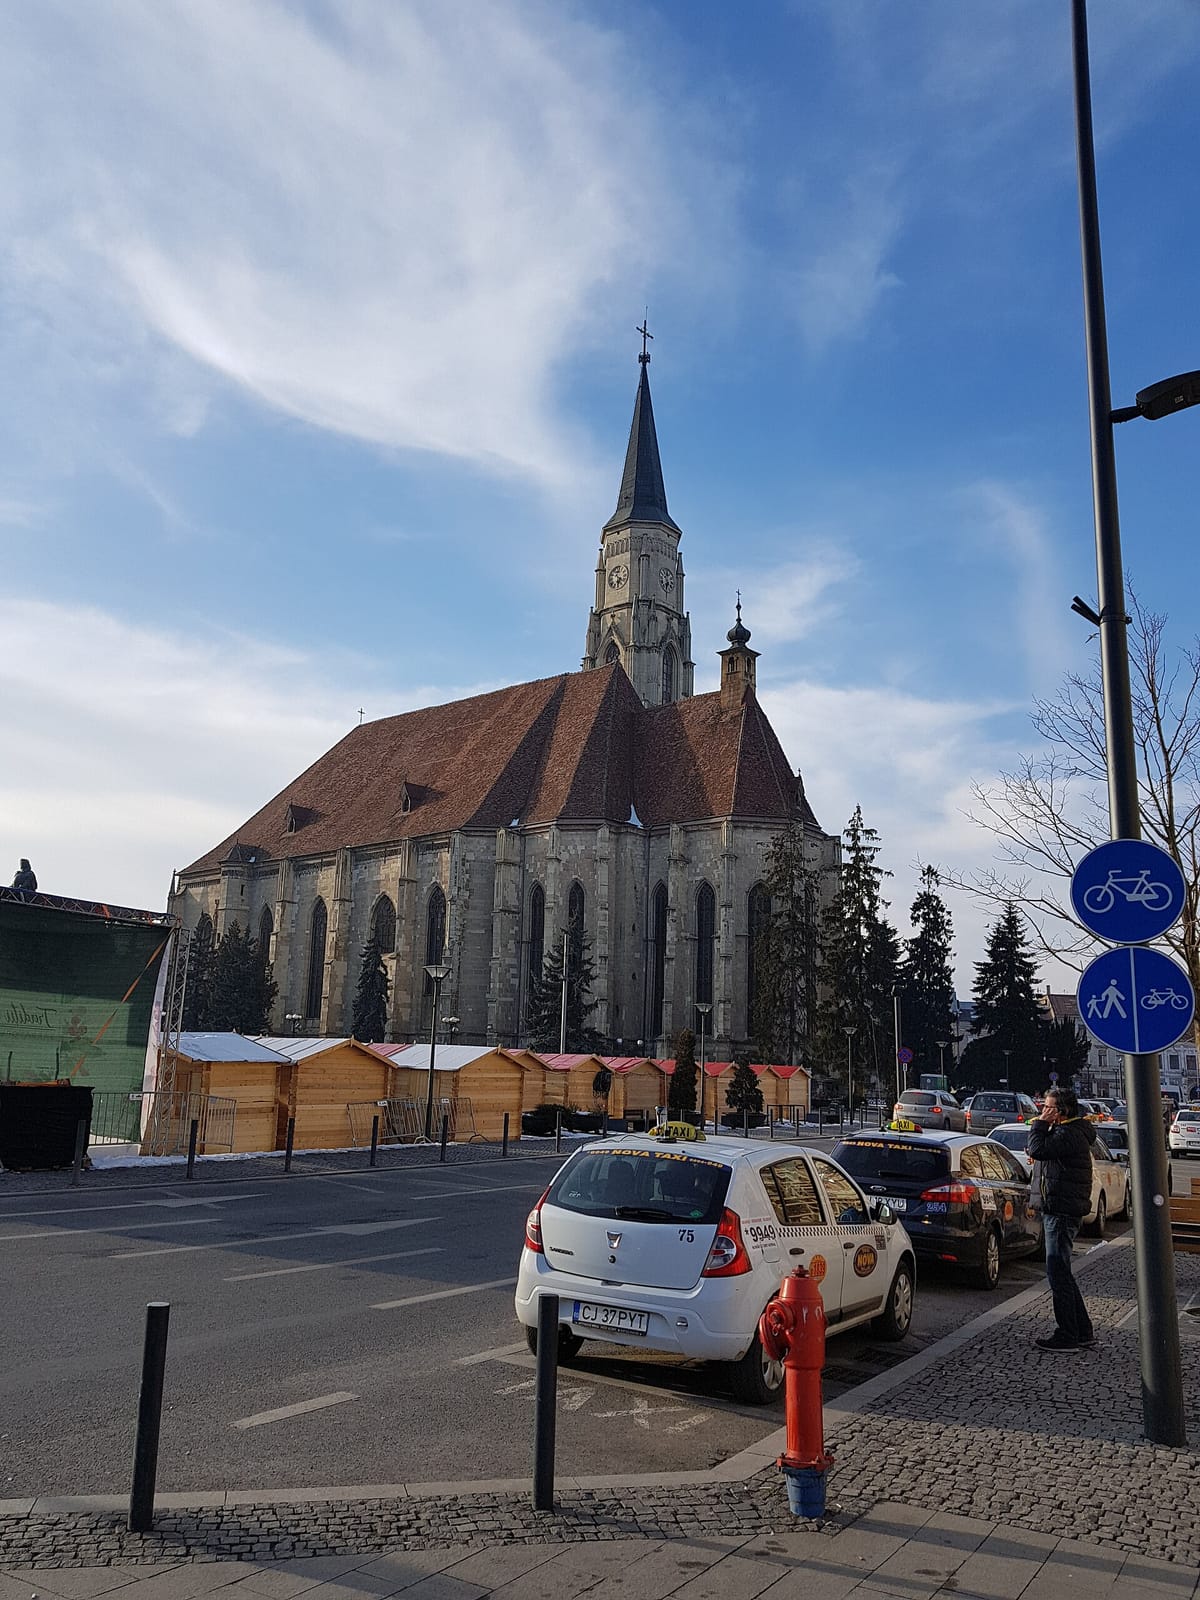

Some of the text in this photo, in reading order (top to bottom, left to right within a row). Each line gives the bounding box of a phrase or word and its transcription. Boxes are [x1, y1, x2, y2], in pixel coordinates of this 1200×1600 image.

[668, 1125, 690, 1138] TAXI
[888, 1143, 912, 1151] TAXI
[611, 1149, 650, 1158] NOVA
[654, 1151, 688, 1162] TAXI
[678, 1228, 695, 1243] 75
[857, 1252, 875, 1266] NOVA
[582, 1305, 598, 1321] CJ
